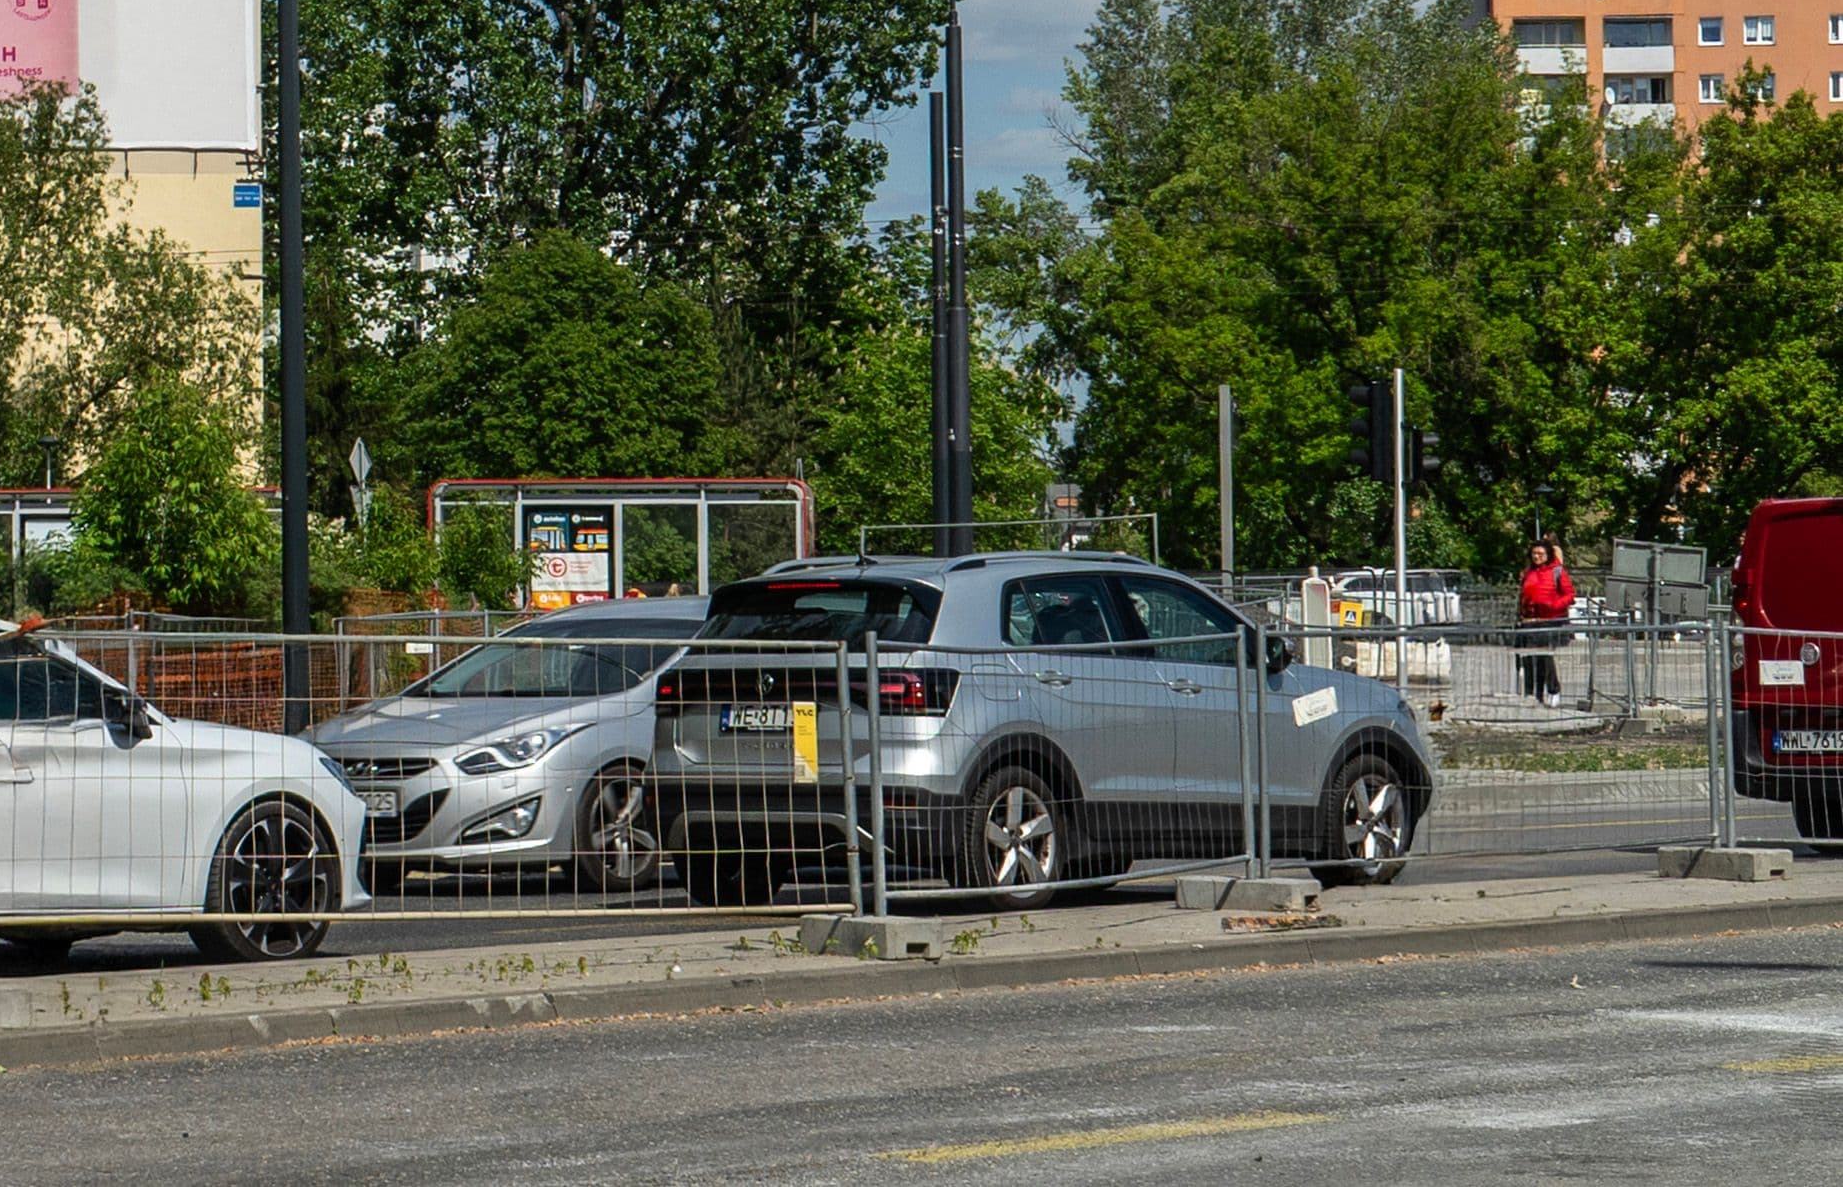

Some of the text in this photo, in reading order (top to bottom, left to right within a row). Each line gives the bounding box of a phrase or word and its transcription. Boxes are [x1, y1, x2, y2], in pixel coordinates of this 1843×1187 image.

[2, 46, 17, 62] H
[759, 705, 794, 726] 8T1
[1779, 732, 1808, 749] WWL
